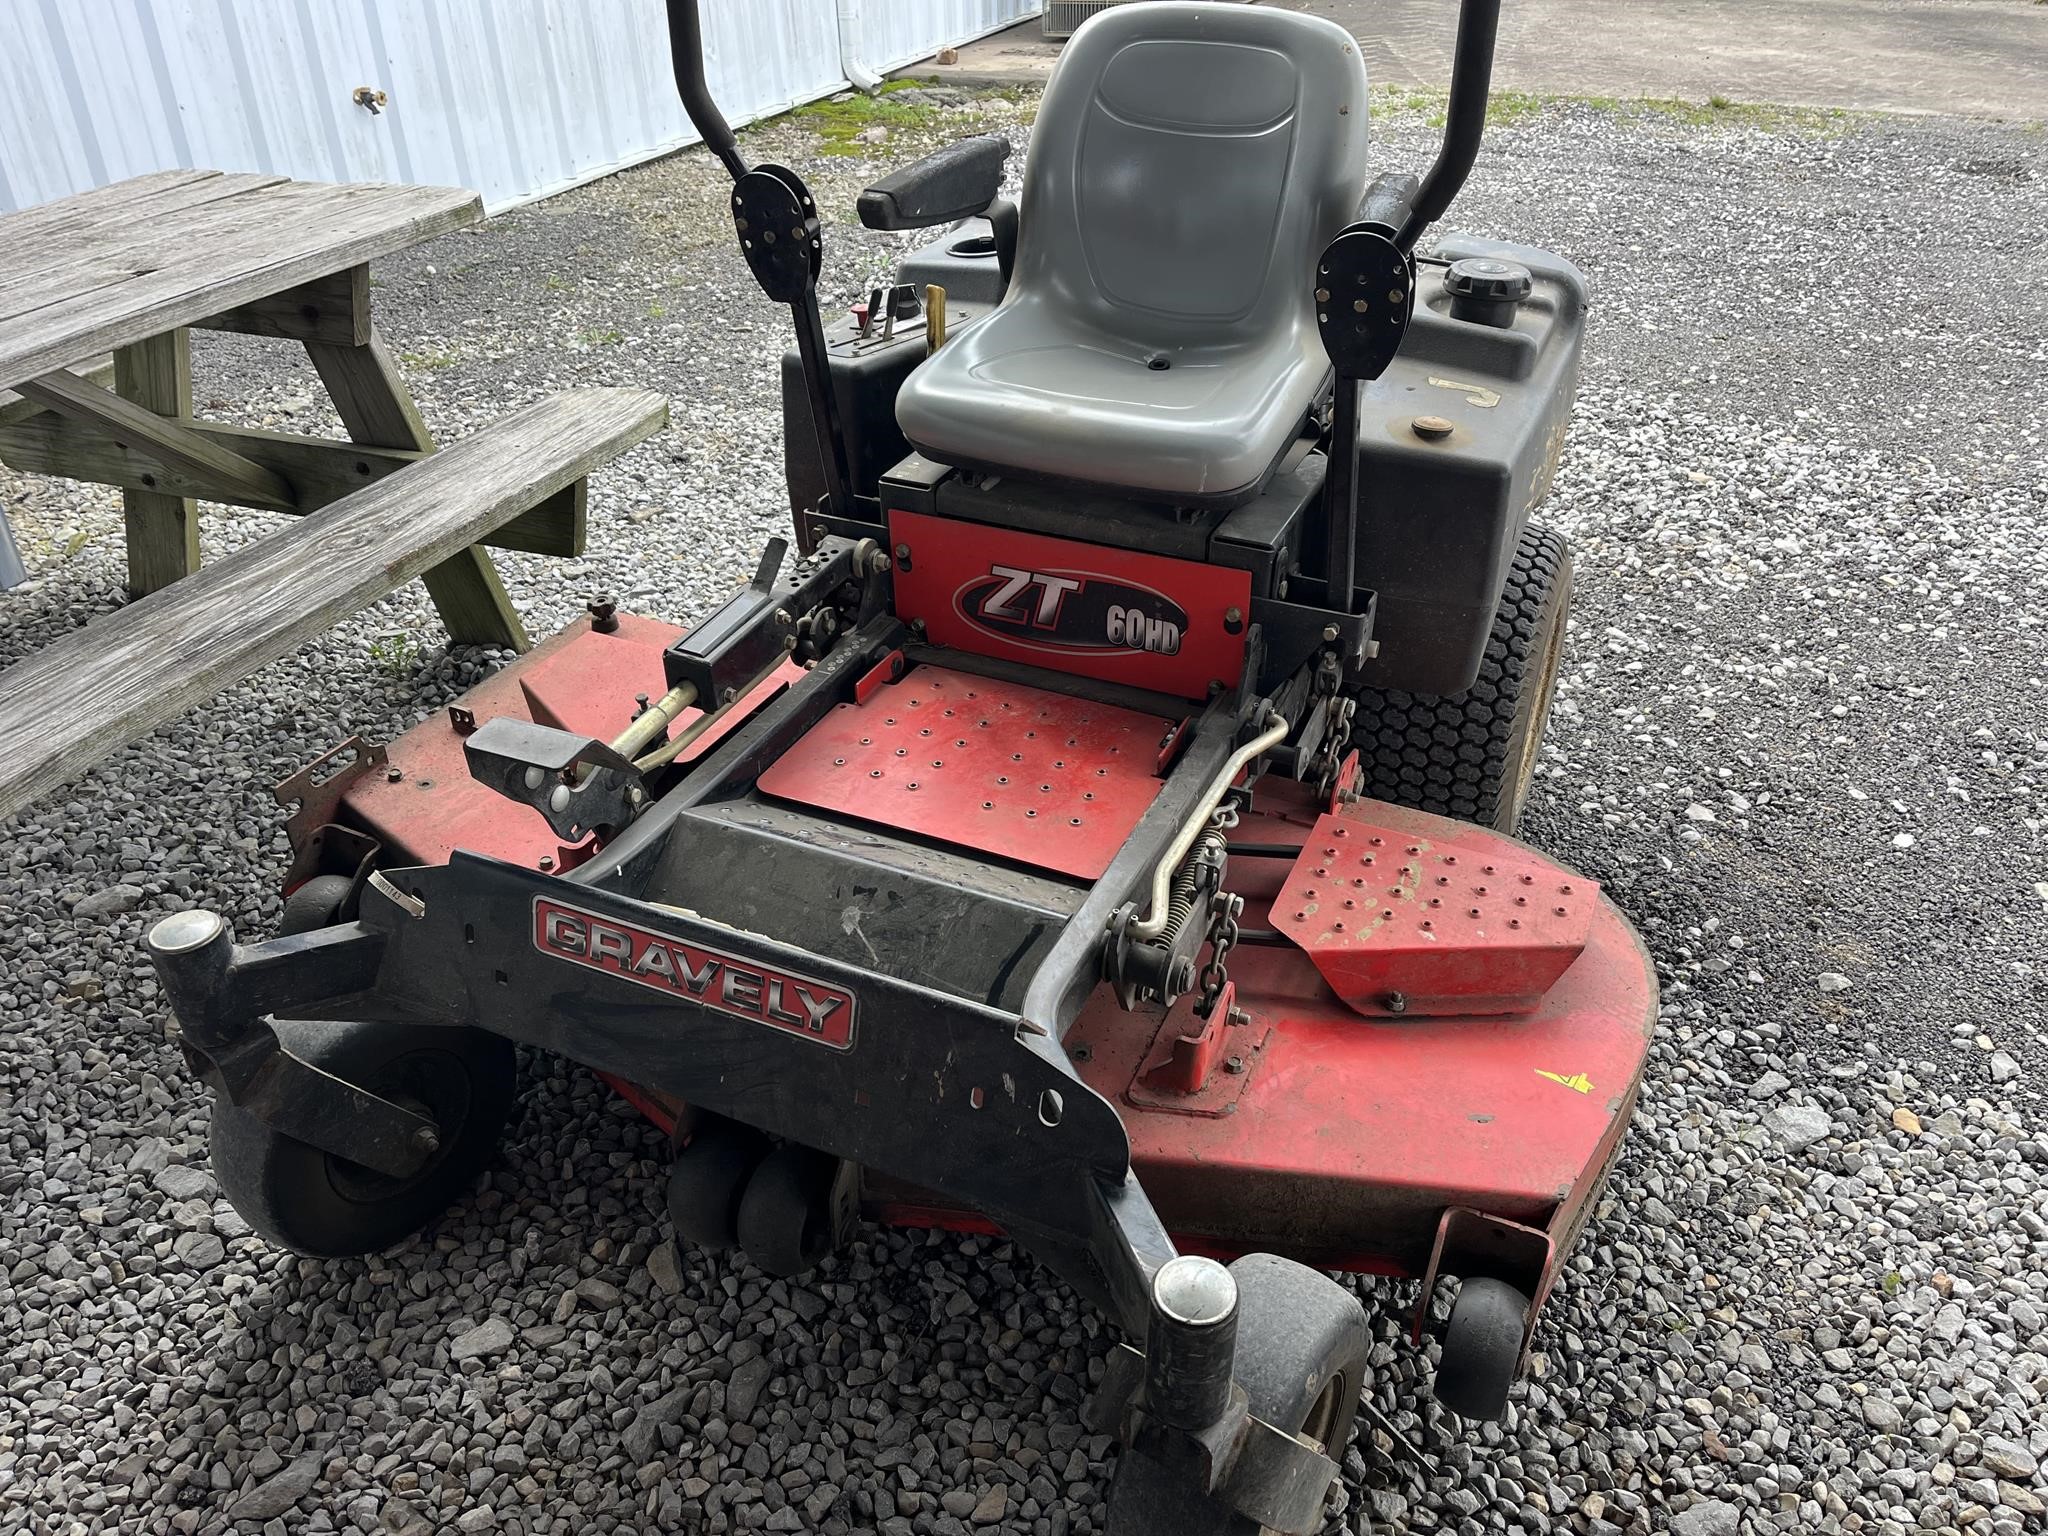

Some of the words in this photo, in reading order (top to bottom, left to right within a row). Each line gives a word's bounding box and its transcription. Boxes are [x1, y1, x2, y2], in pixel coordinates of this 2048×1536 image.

[979, 565, 1083, 630] ZT
[1106, 605, 1181, 655] 60HD
[546, 912, 843, 1031] GRAVELY
